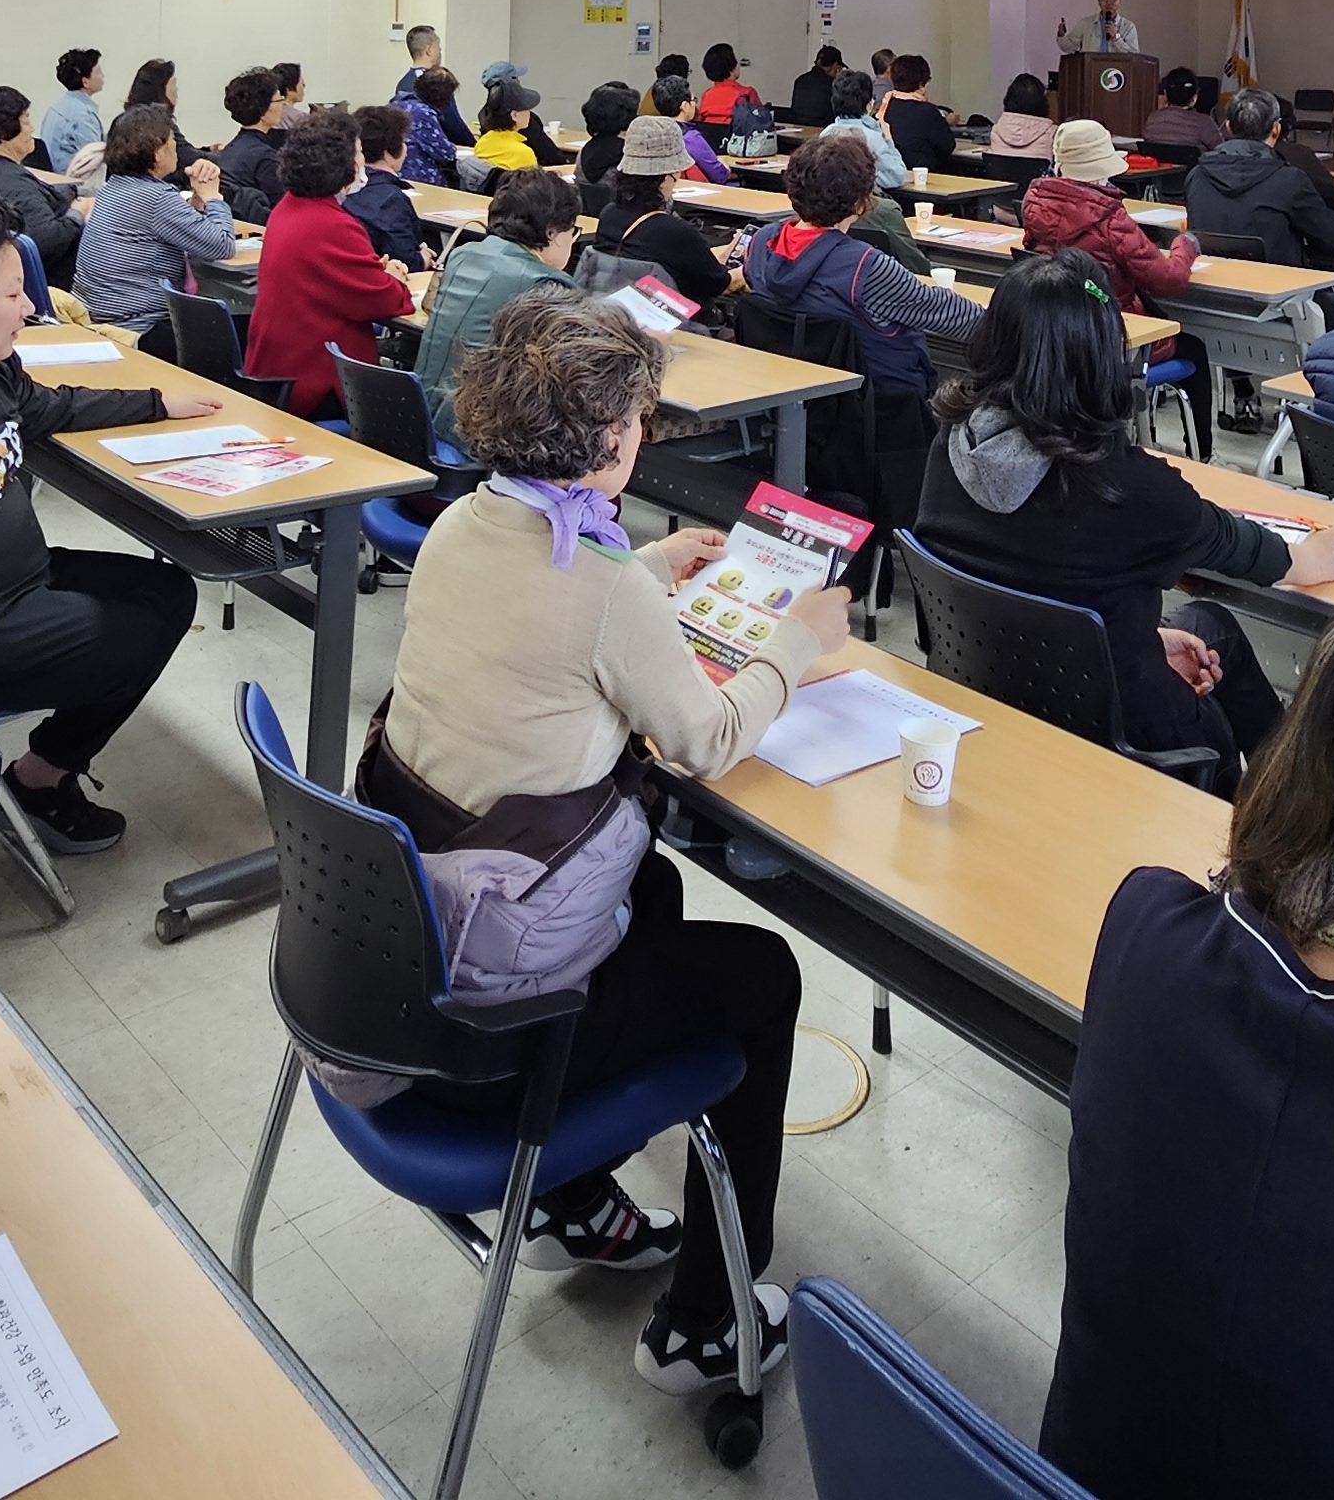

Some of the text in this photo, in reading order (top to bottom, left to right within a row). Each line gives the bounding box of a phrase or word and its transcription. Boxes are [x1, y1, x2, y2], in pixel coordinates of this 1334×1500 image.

[11, 1340, 35, 1367] 수업
[25, 1367, 55, 1403] 만족도
[45, 1402, 70, 1430] 조사
